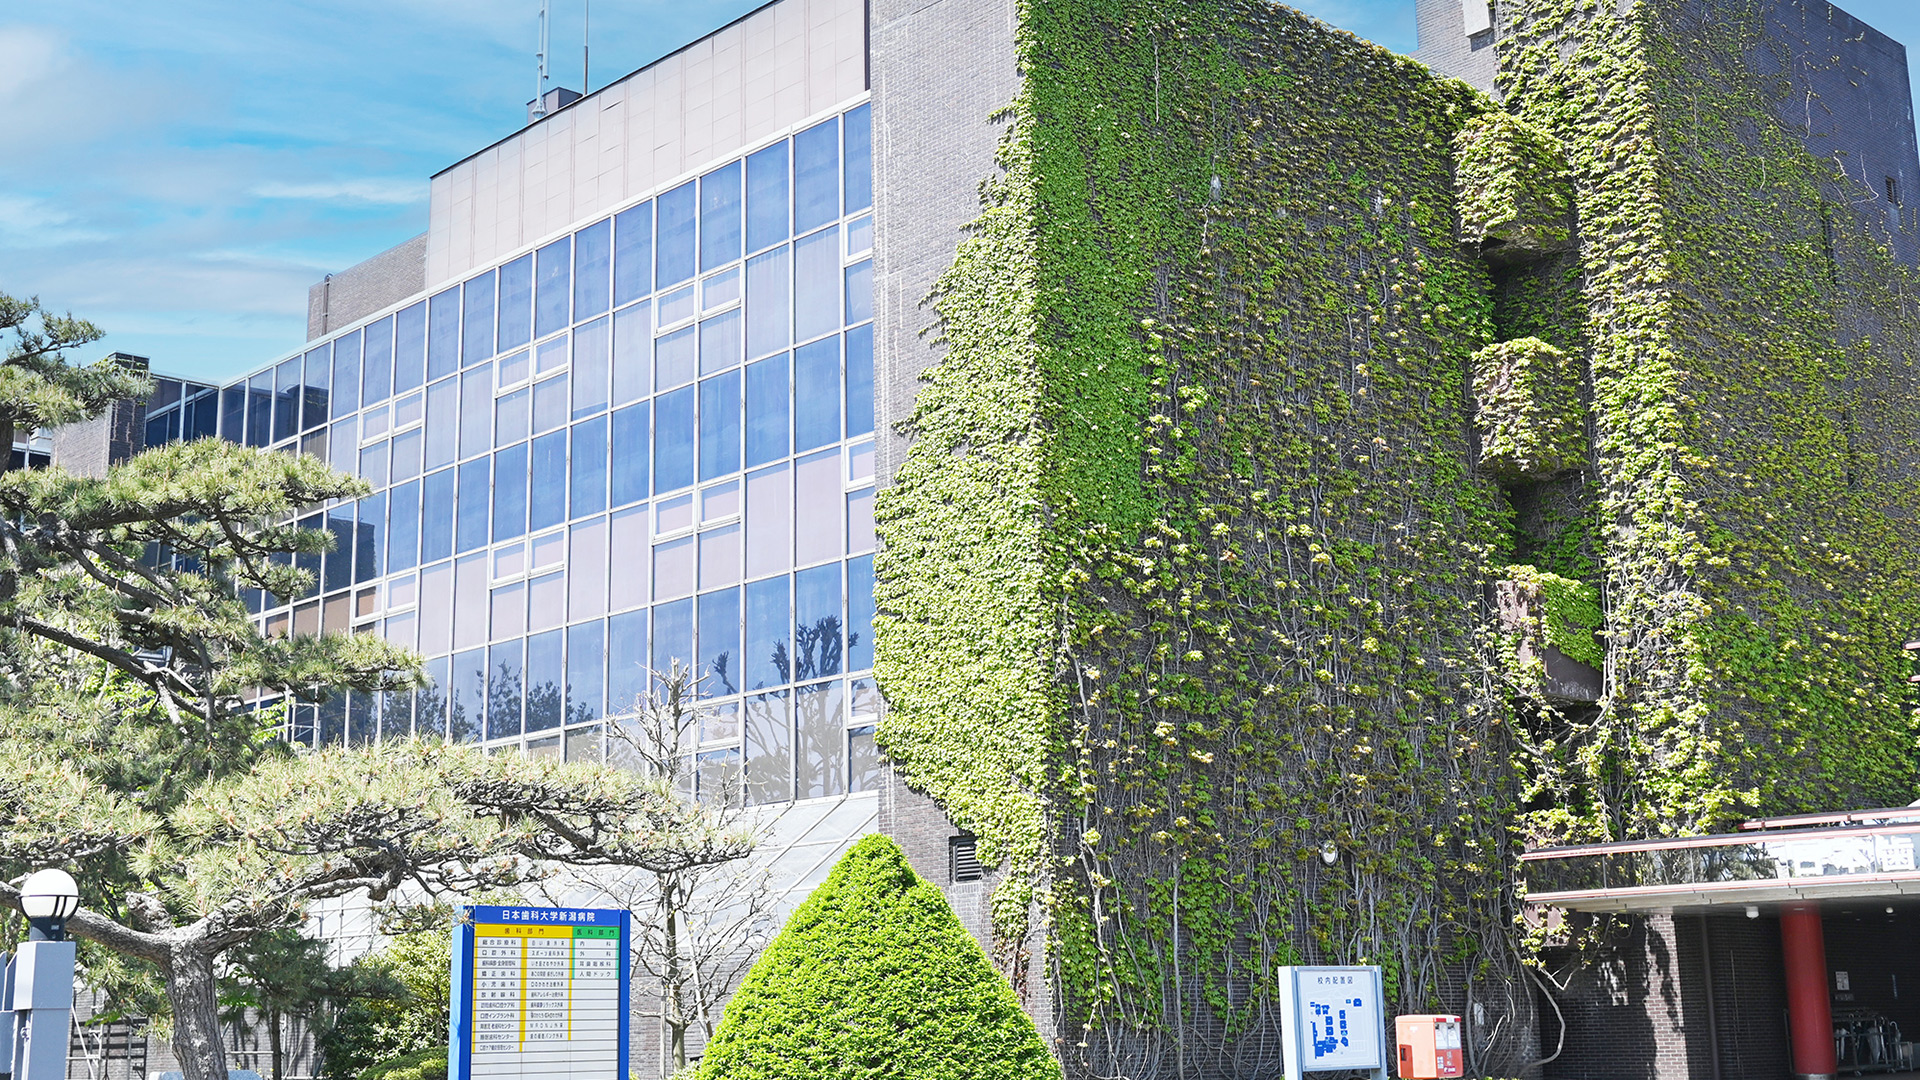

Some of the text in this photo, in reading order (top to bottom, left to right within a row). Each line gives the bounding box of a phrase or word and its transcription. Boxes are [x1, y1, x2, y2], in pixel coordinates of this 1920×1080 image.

[503, 910, 595, 922] 日本歯科大学新潟病院
[577, 929, 615, 937] 医科部門
